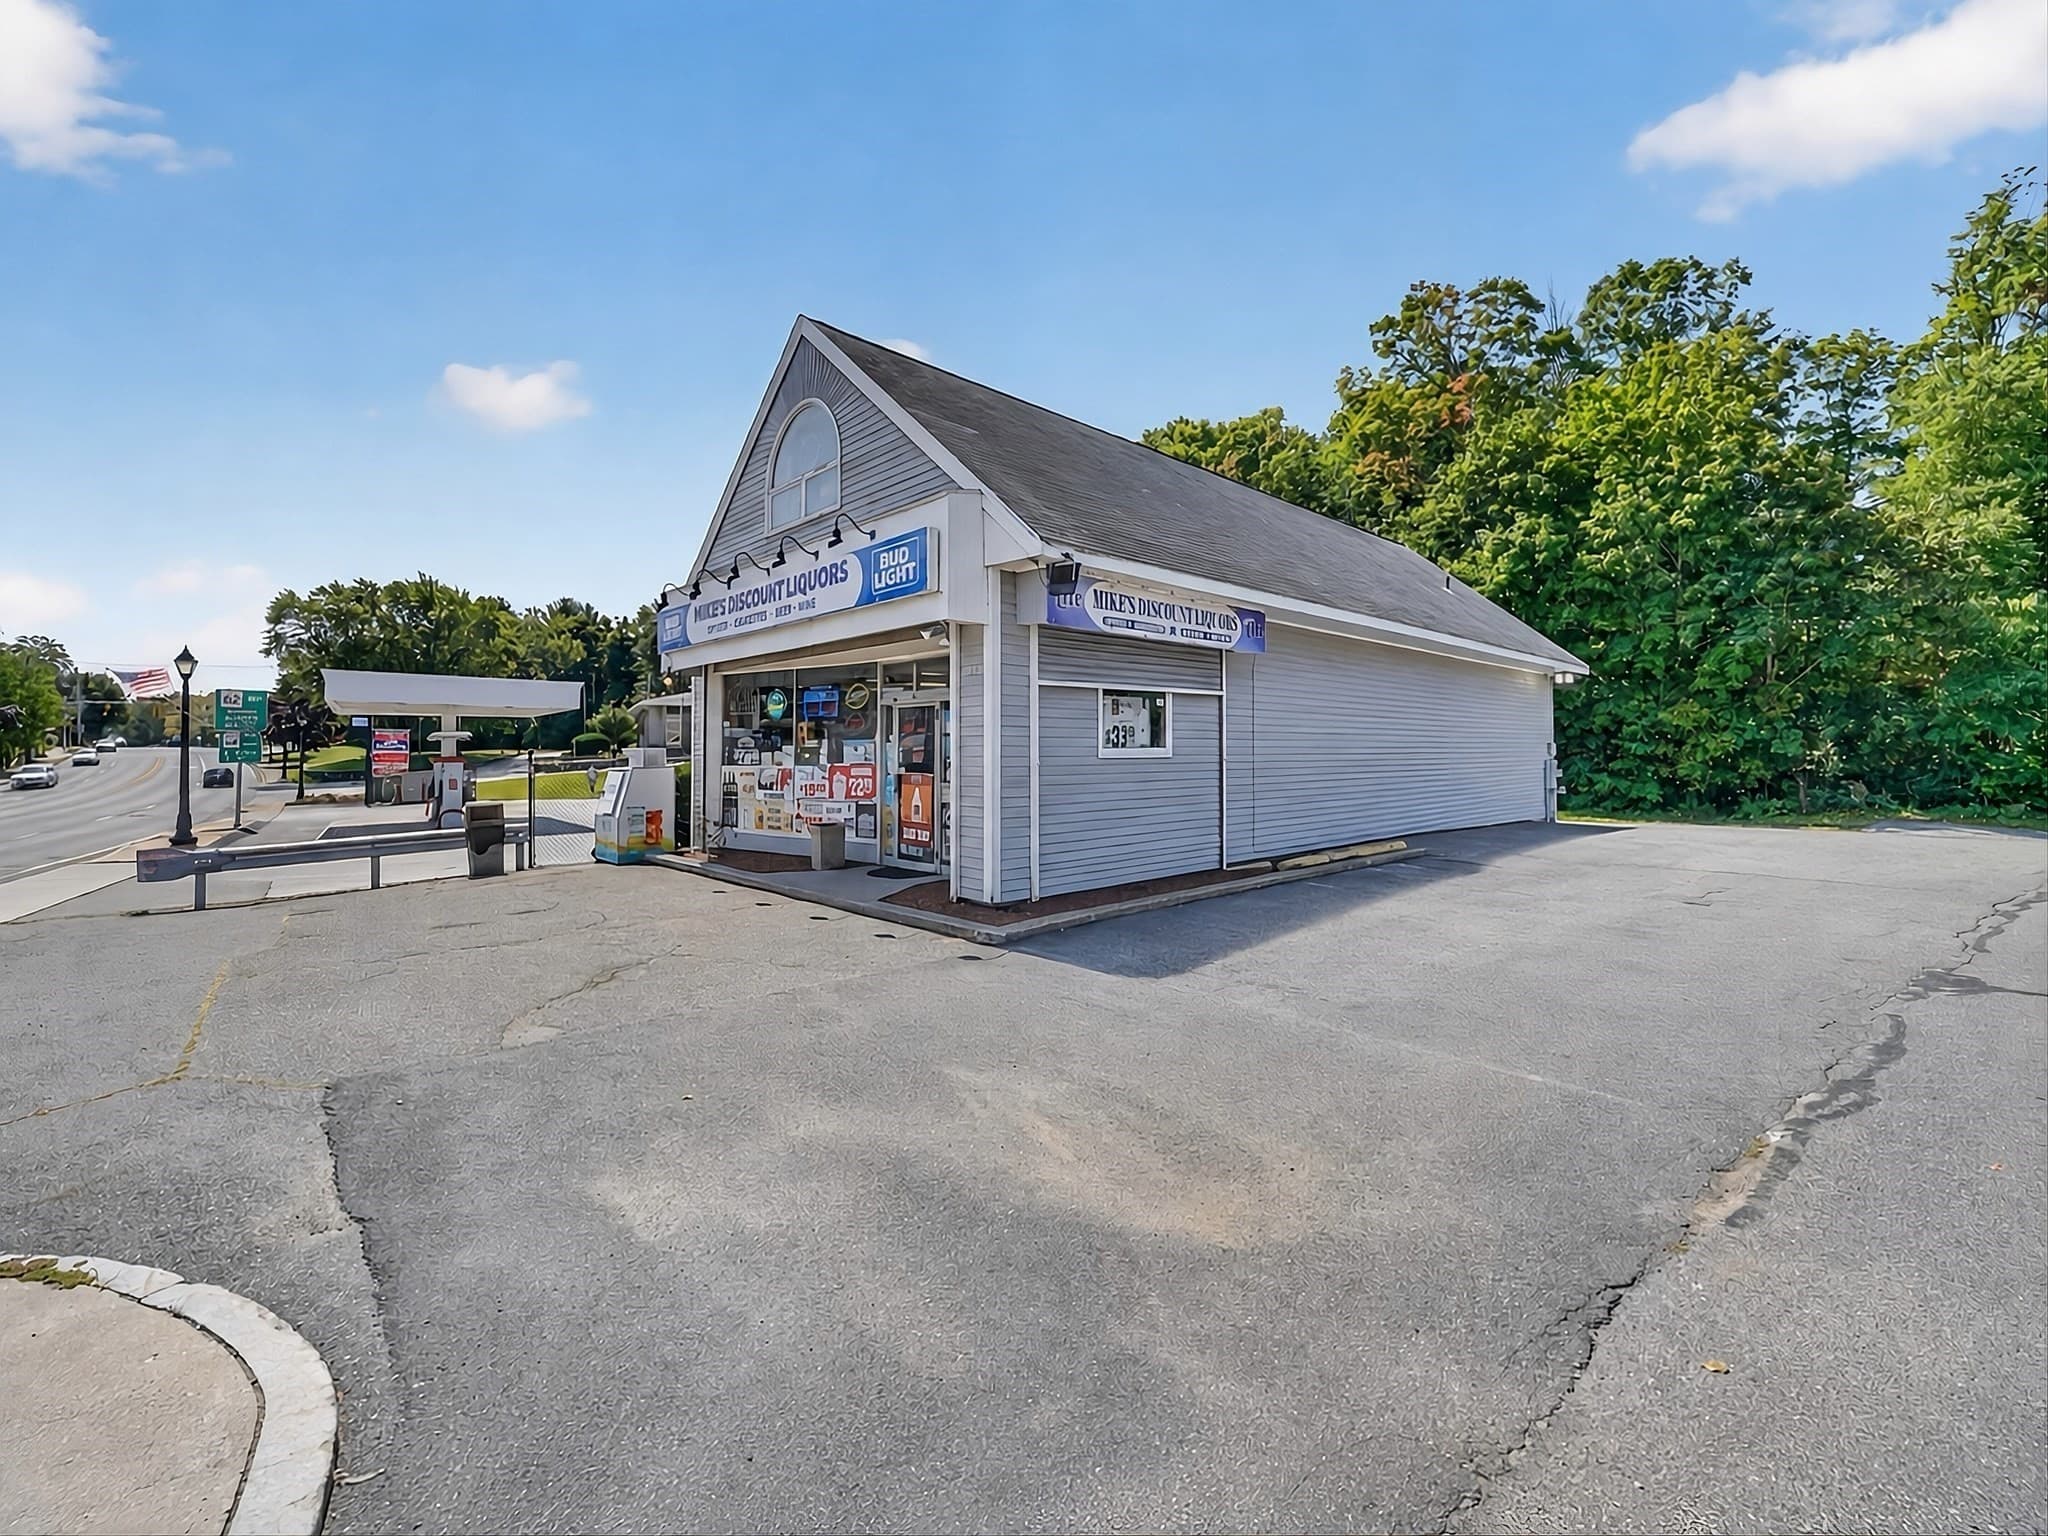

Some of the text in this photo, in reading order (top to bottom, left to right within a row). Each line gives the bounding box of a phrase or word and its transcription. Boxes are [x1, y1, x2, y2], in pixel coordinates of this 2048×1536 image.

[879, 546, 910, 570] BUD
[694, 559, 849, 623] MIKE'S DISCOUNT LIQUORS
[874, 562, 917, 590] LIGHT
[1093, 589, 1136, 614] MIKE'S
[1139, 598, 1193, 625] DISCOUNT
[1195, 608, 1238, 632] LIQUORS
